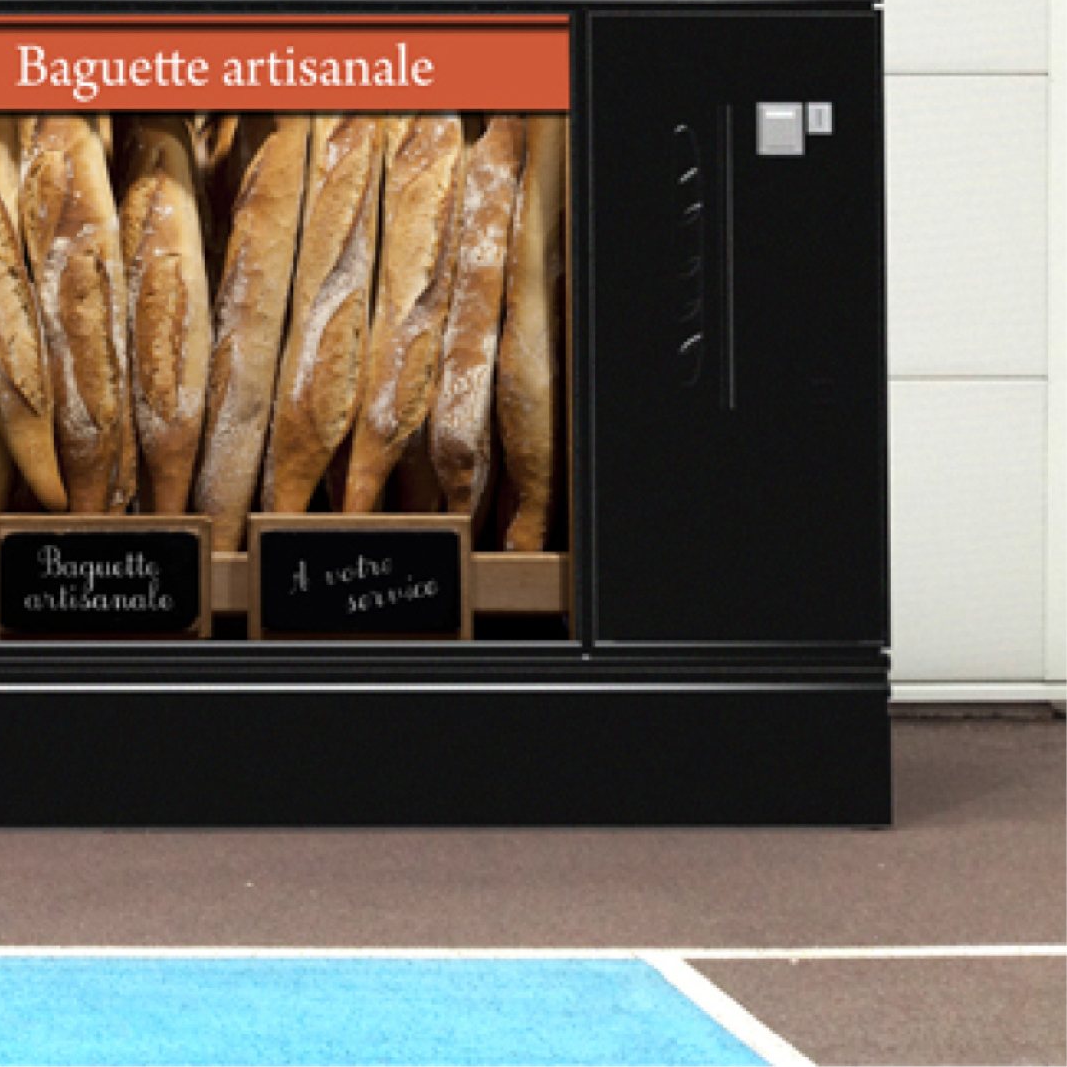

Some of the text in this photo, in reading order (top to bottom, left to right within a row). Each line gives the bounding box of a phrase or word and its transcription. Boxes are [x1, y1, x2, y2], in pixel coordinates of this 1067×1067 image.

[16, 42, 434, 103] Baguette artisanale
[36, 544, 160, 592] Baguette
[325, 554, 393, 585] votre
[23, 580, 175, 611] artisanale
[345, 574, 438, 614] service
